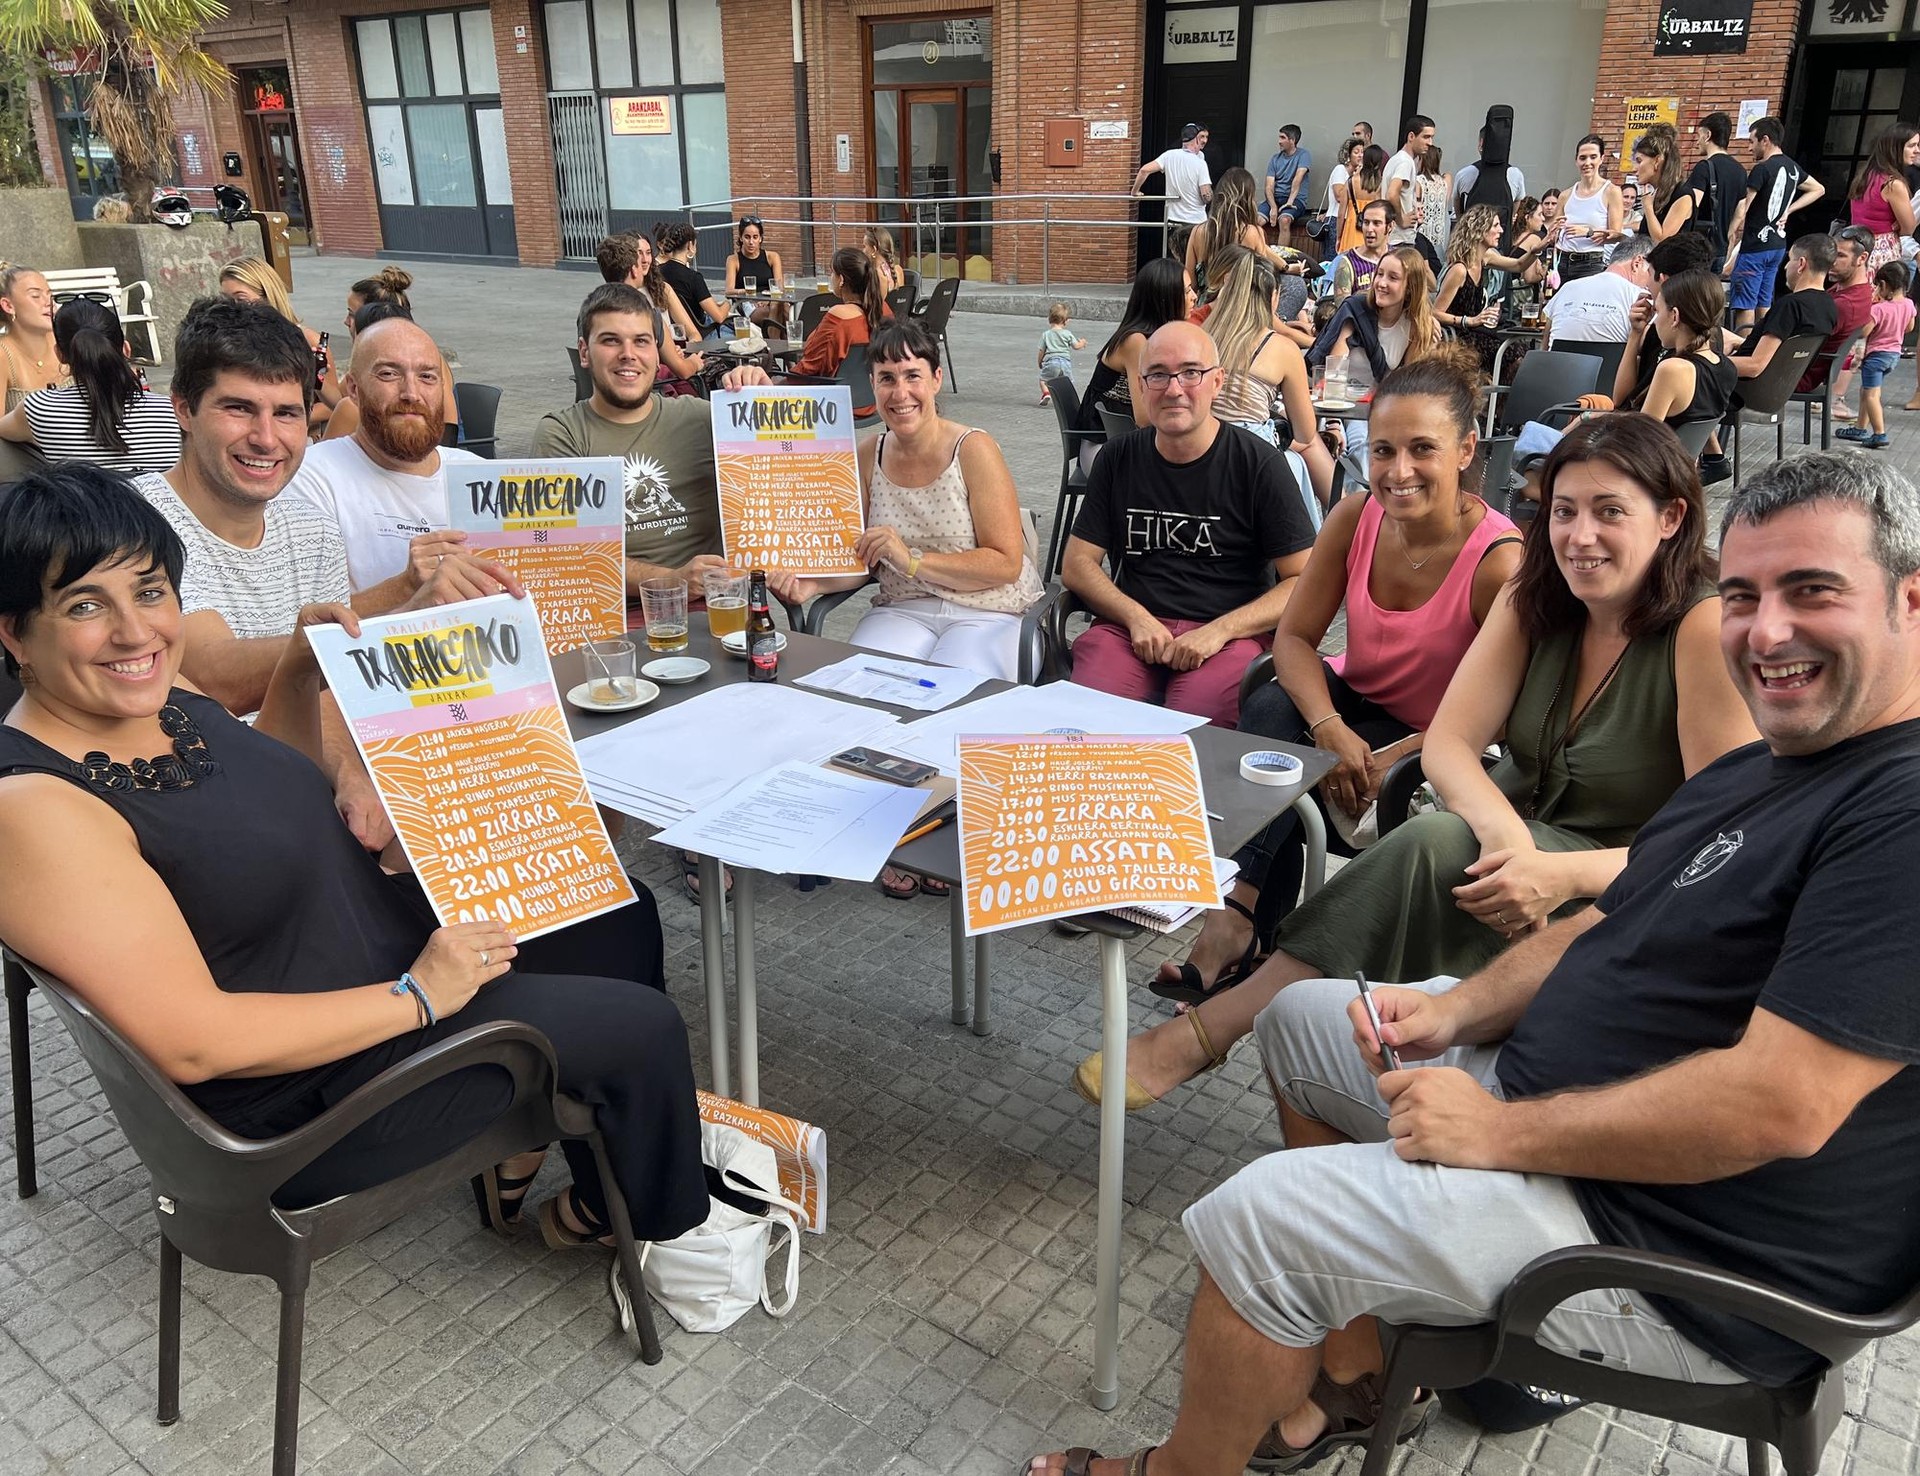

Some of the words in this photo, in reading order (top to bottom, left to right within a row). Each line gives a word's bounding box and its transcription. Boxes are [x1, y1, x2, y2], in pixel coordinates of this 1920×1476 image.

[1669, 19, 1744, 34] URBALTZ
[1174, 30, 1235, 44] URBALTZ
[628, 102, 662, 112] ARANZABAL
[1630, 104, 1658, 112] UTOPIAK
[744, 498, 770, 506] 17:00
[743, 508, 771, 518] 19:00
[774, 506, 834, 519] ZIRRARA
[396, 524, 430, 533] aurrera
[740, 520, 773, 531] 20:30
[737, 533, 780, 548] 22:00
[785, 532, 844, 548] ASSATA
[1125, 514, 1222, 556] HIKA
[497, 549, 519, 558] 11:00
[522, 546, 546, 554] JAIXEN
[548, 545, 580, 553] HASIERIA
[734, 550, 780, 568] 00:00
[814, 546, 857, 556] TAILERRA
[782, 558, 804, 568] GAU
[807, 556, 856, 568] GIROTUA
[548, 578, 591, 587] BAZKAIXA
[548, 587, 594, 598] MUSIKATUA
[542, 597, 598, 608] TXAPELKETIA
[541, 606, 593, 627] RRARA
[386, 618, 440, 636] IRAILAK
[430, 690, 468, 702] JAIXAK
[418, 732, 444, 748] 11:00
[446, 728, 474, 738] JAIXEN
[474, 720, 510, 733] HASIERIA
[420, 746, 448, 762] 12:00
[449, 742, 475, 751] PREGOIA
[422, 763, 454, 780] 12:30
[454, 757, 473, 768] HAUR
[474, 755, 492, 764] JOLAS
[492, 752, 504, 760] ETA
[506, 746, 528, 756] PARKIA
[1012, 762, 1046, 772] 12:30
[426, 780, 458, 798] 14:30
[458, 772, 490, 789] HERRI
[491, 762, 540, 782] BAZKAIXA
[1008, 772, 1044, 785] 14:30
[1047, 771, 1084, 780] HERRI
[1090, 772, 1150, 780] BAZKAIXA
[1049, 783, 1084, 792] BINGO
[1088, 782, 1156, 792] MUSIKATUA
[464, 788, 496, 803] BINGO
[496, 775, 550, 796] MUSIKATUA
[430, 808, 468, 829] 17:00
[472, 802, 494, 817] MUS
[494, 787, 559, 810] TXAPELKETIA
[1002, 795, 1044, 810] 17:00
[1051, 794, 1076, 804] MUS
[1080, 794, 1163, 802] TXAPELKETIA
[997, 810, 1044, 827] 19:00
[1052, 803, 1156, 823] ZIRRARA
[434, 826, 478, 851] 19:00
[478, 803, 561, 840] ZIRRARA
[991, 826, 1048, 848] 20:30
[1052, 822, 1107, 832] ESKILERA
[1110, 821, 1174, 831] BERTIKALA
[1050, 831, 1099, 842] RADARRA
[1102, 830, 1149, 840] ALDAPAN
[1152, 831, 1180, 840] GORA
[441, 846, 489, 873] 20:30
[488, 834, 530, 852] ESKILERA
[530, 821, 578, 840] BERTIKALA
[491, 843, 530, 863] RADARRA
[530, 836, 564, 852] ALDAPAN
[563, 830, 585, 844] GORA
[986, 844, 1060, 876] 22:00
[1070, 839, 1176, 864] ASSATA
[448, 866, 511, 900] 22:00
[512, 844, 590, 884] ASSATA
[518, 881, 559, 900] XUNBA
[558, 862, 612, 888] TAILERRA
[979, 872, 1058, 912] 00:00
[1062, 864, 1118, 879] XUNBA
[1122, 862, 1200, 876] TAILERRA
[1062, 879, 1102, 898] GAU
[1109, 875, 1200, 892] GIROTUA
[525, 897, 556, 918] GAU
[557, 877, 618, 908] GIROTUA
[1000, 908, 1038, 921] JAIXETAN
[713, 1110, 761, 1132] BAZKAIXA
